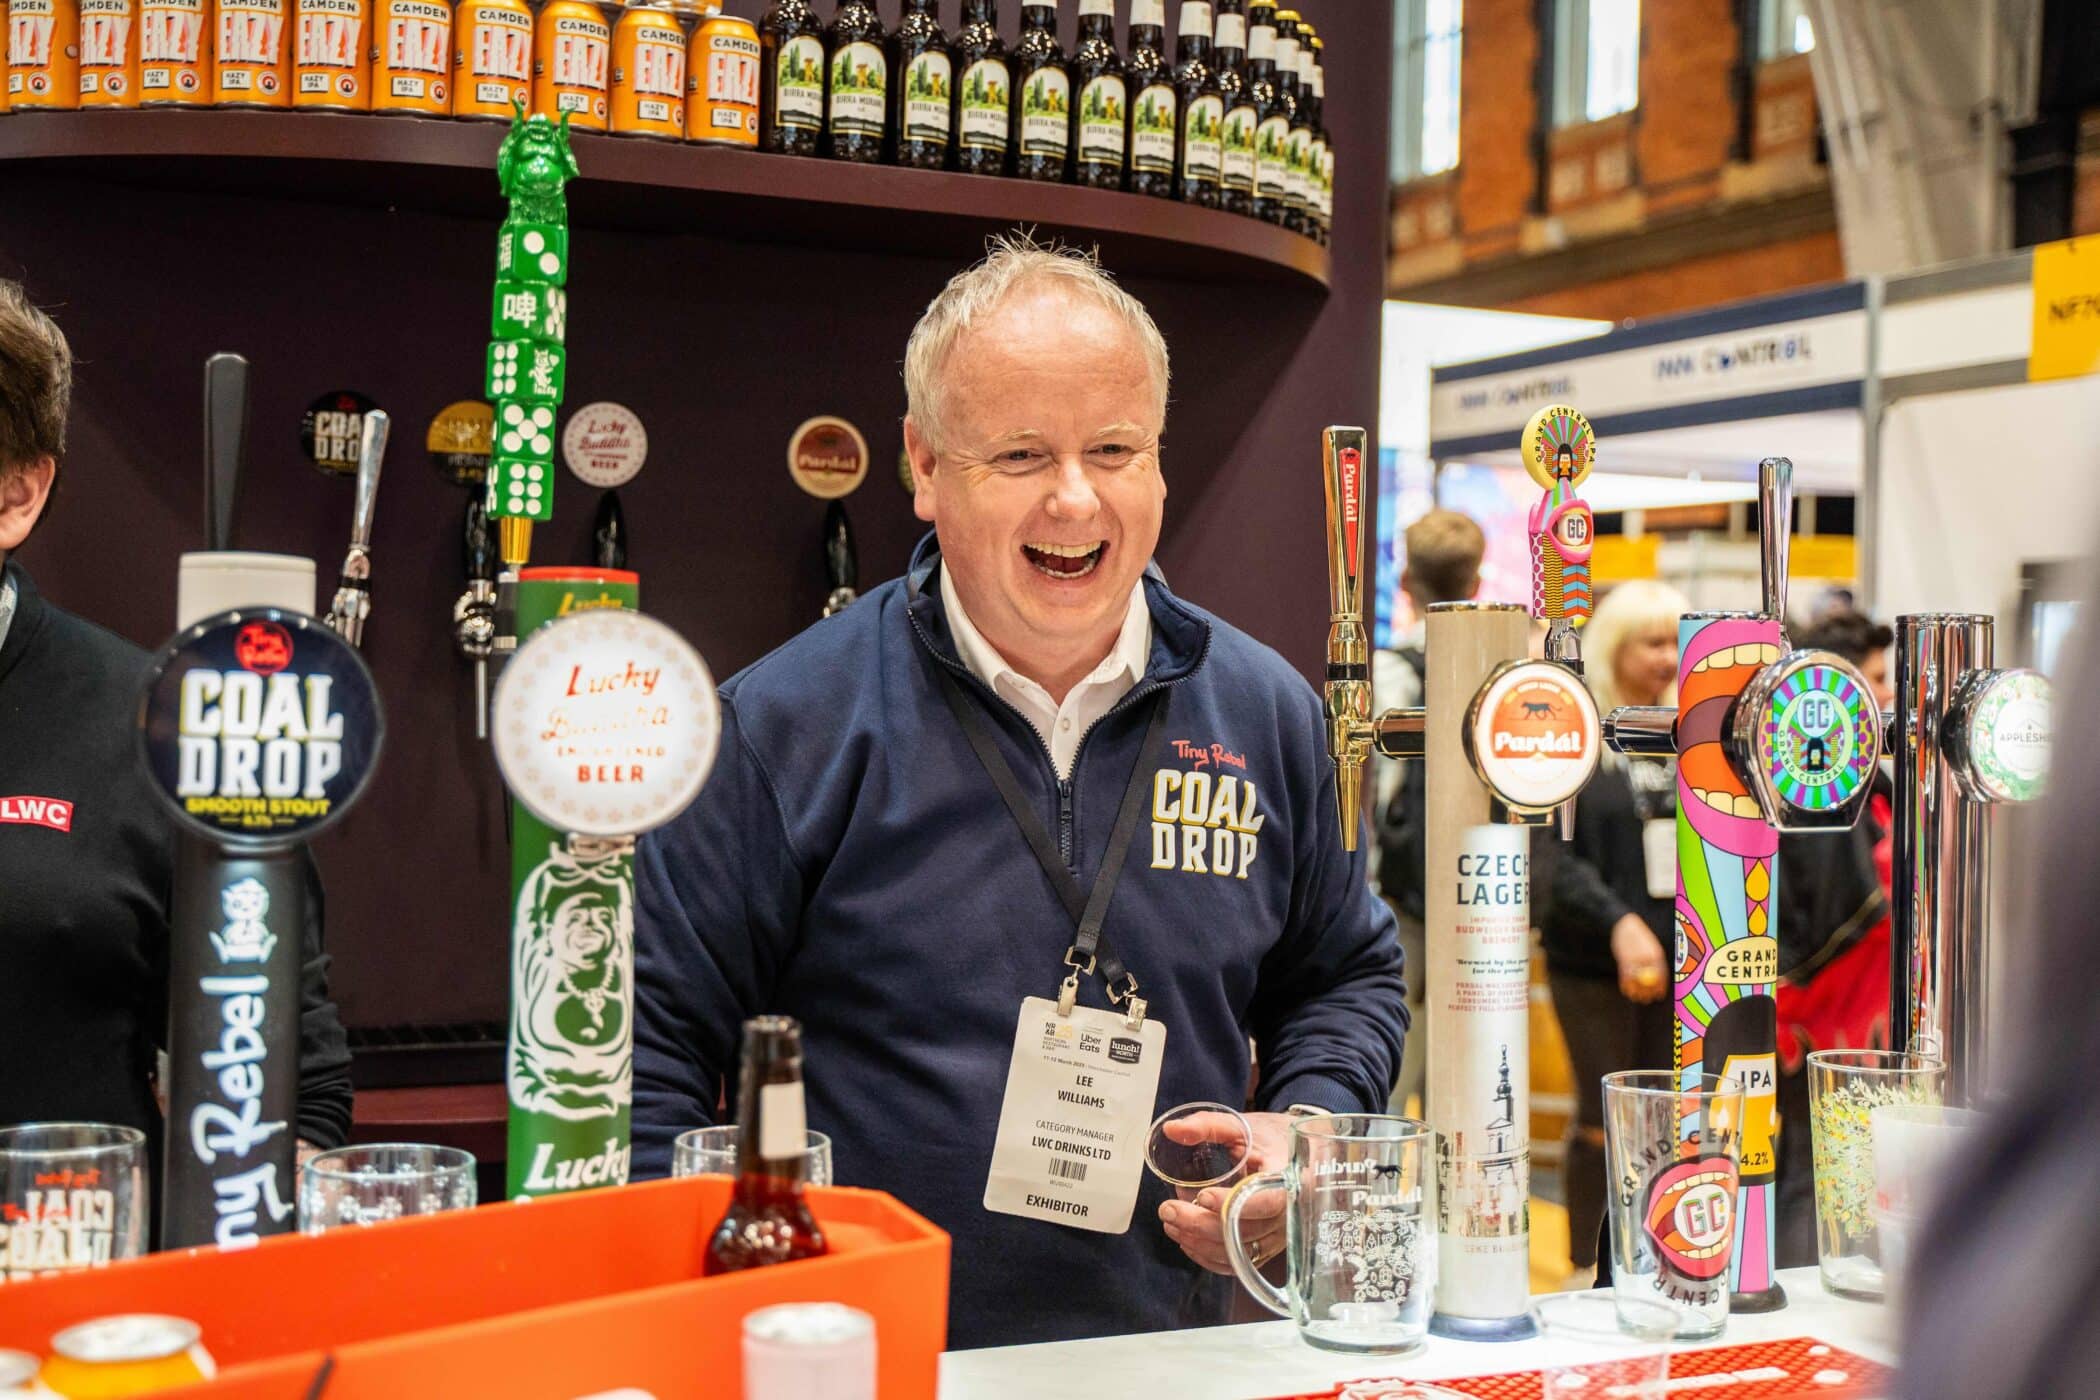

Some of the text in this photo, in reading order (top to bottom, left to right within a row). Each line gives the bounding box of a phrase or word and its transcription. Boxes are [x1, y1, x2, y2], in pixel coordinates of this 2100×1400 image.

[302, 0, 356, 12] CAMDEN
[393, 3, 448, 20] CAMDEN
[479, 10, 531, 27] CAMDEN
[560, 20, 609, 38] CAMDEN
[641, 29, 686, 46] CAMDEN
[713, 38, 759, 54] CAMDEN
[502, 291, 537, 329] 啤
[315, 411, 362, 438] COA
[1535, 407, 1596, 463] GRAND CENTRAL IPA
[315, 437, 361, 461] DRO
[1567, 518, 1585, 540] GC
[565, 660, 661, 698] Lucky
[179, 669, 345, 741] COAL
[1803, 699, 1830, 729] GC
[177, 736, 342, 799] DROP
[1171, 739, 1247, 772] Tiny Rebel
[1779, 730, 1843, 784] GRAND CENTRAL
[577, 764, 645, 784] BEER
[1, 799, 68, 825] LWC
[186, 797, 331, 817] SMOOTH STOUT
[1152, 768, 1265, 834] COAL
[1151, 822, 1258, 879] DROP
[1080, 1042, 1100, 1053] Eats
[1081, 1032, 1101, 1044] Uber
[1112, 1040, 1140, 1053] lunch!
[190, 974, 288, 1165] Rebel
[1076, 1075, 1094, 1088] LEE
[1740, 1069, 1772, 1089] IPA
[1058, 1090, 1105, 1109] WILLIAMS
[1035, 1119, 1114, 1143] CATEGORY MANAGER
[1032, 1135, 1111, 1161] LWC DRINKS LTD
[1740, 1151, 1769, 1167] 4.2%
[523, 1137, 632, 1187] Lucky
[1620, 1138, 1672, 1208] GRAND
[1026, 1194, 1089, 1217] EXHIBITOR
[1683, 1190, 1725, 1240] GC
